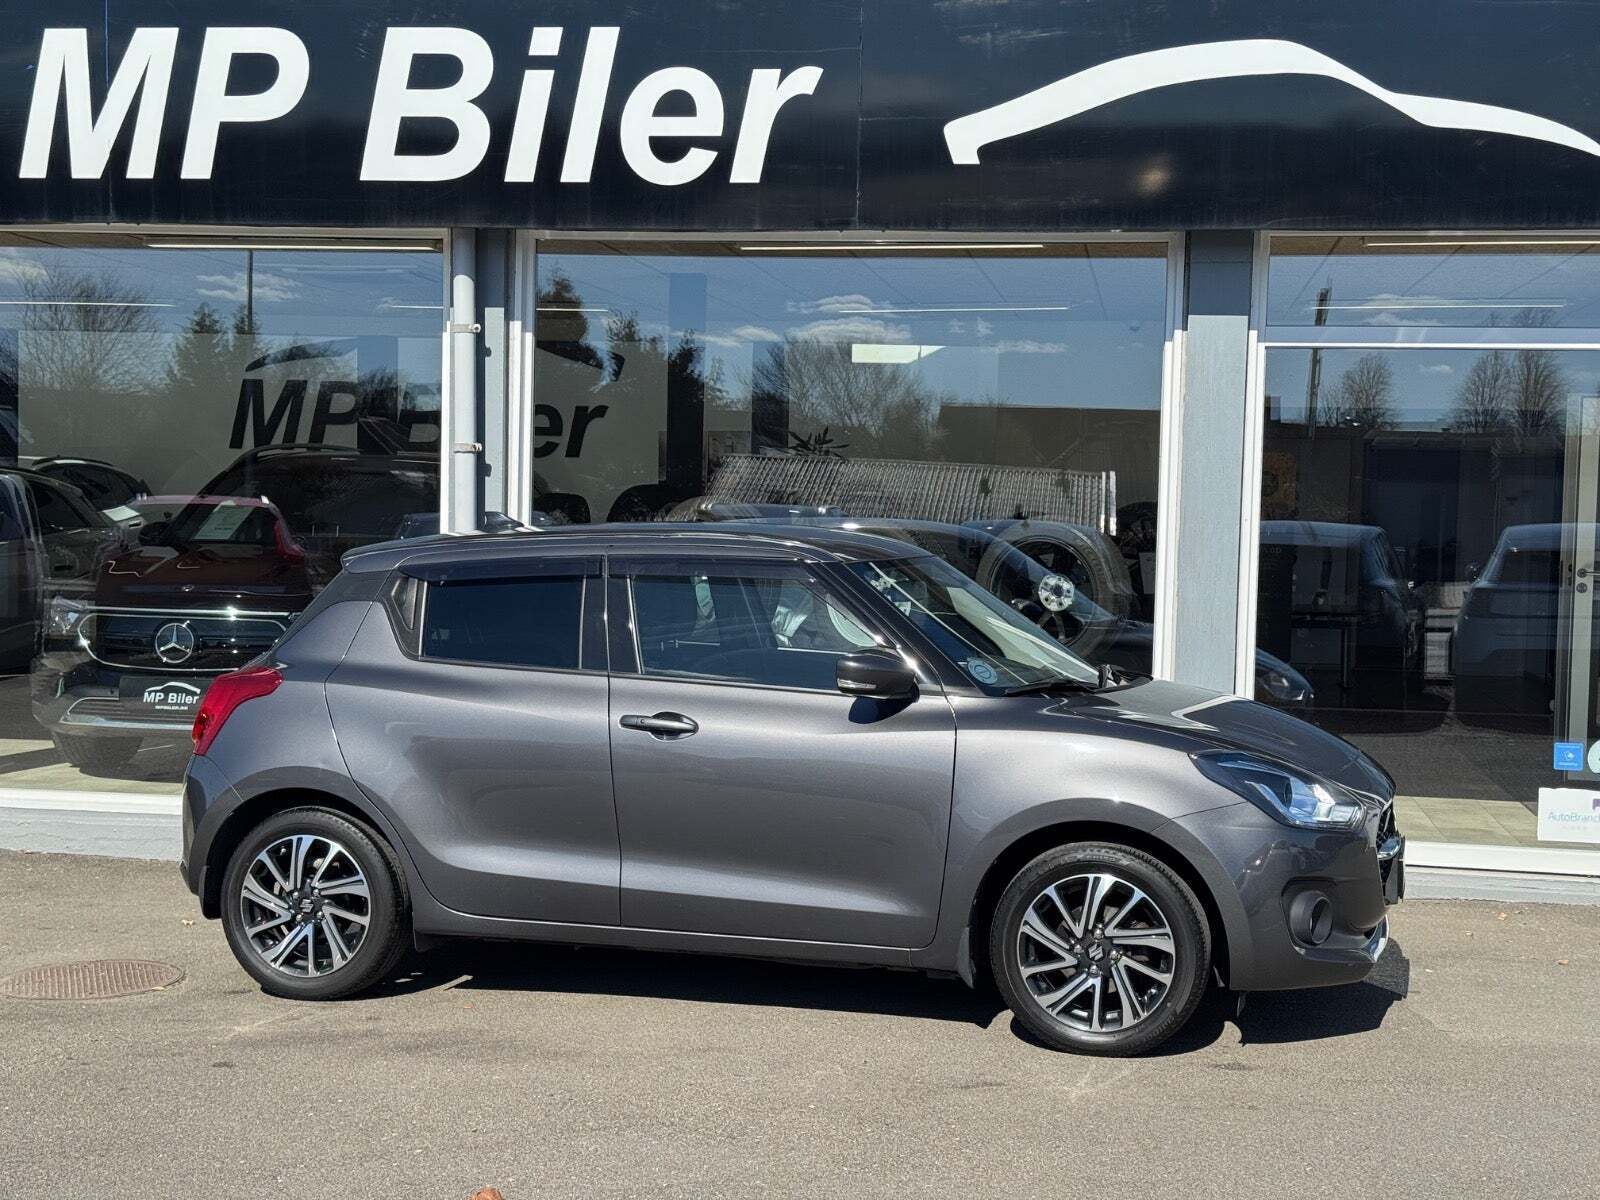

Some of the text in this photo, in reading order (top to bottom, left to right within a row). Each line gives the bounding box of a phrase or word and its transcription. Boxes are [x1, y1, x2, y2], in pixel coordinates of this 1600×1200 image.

[19, 26, 824, 187] MP Biler
[229, 378, 361, 450] MP
[143, 692, 200, 704] MP Biler
